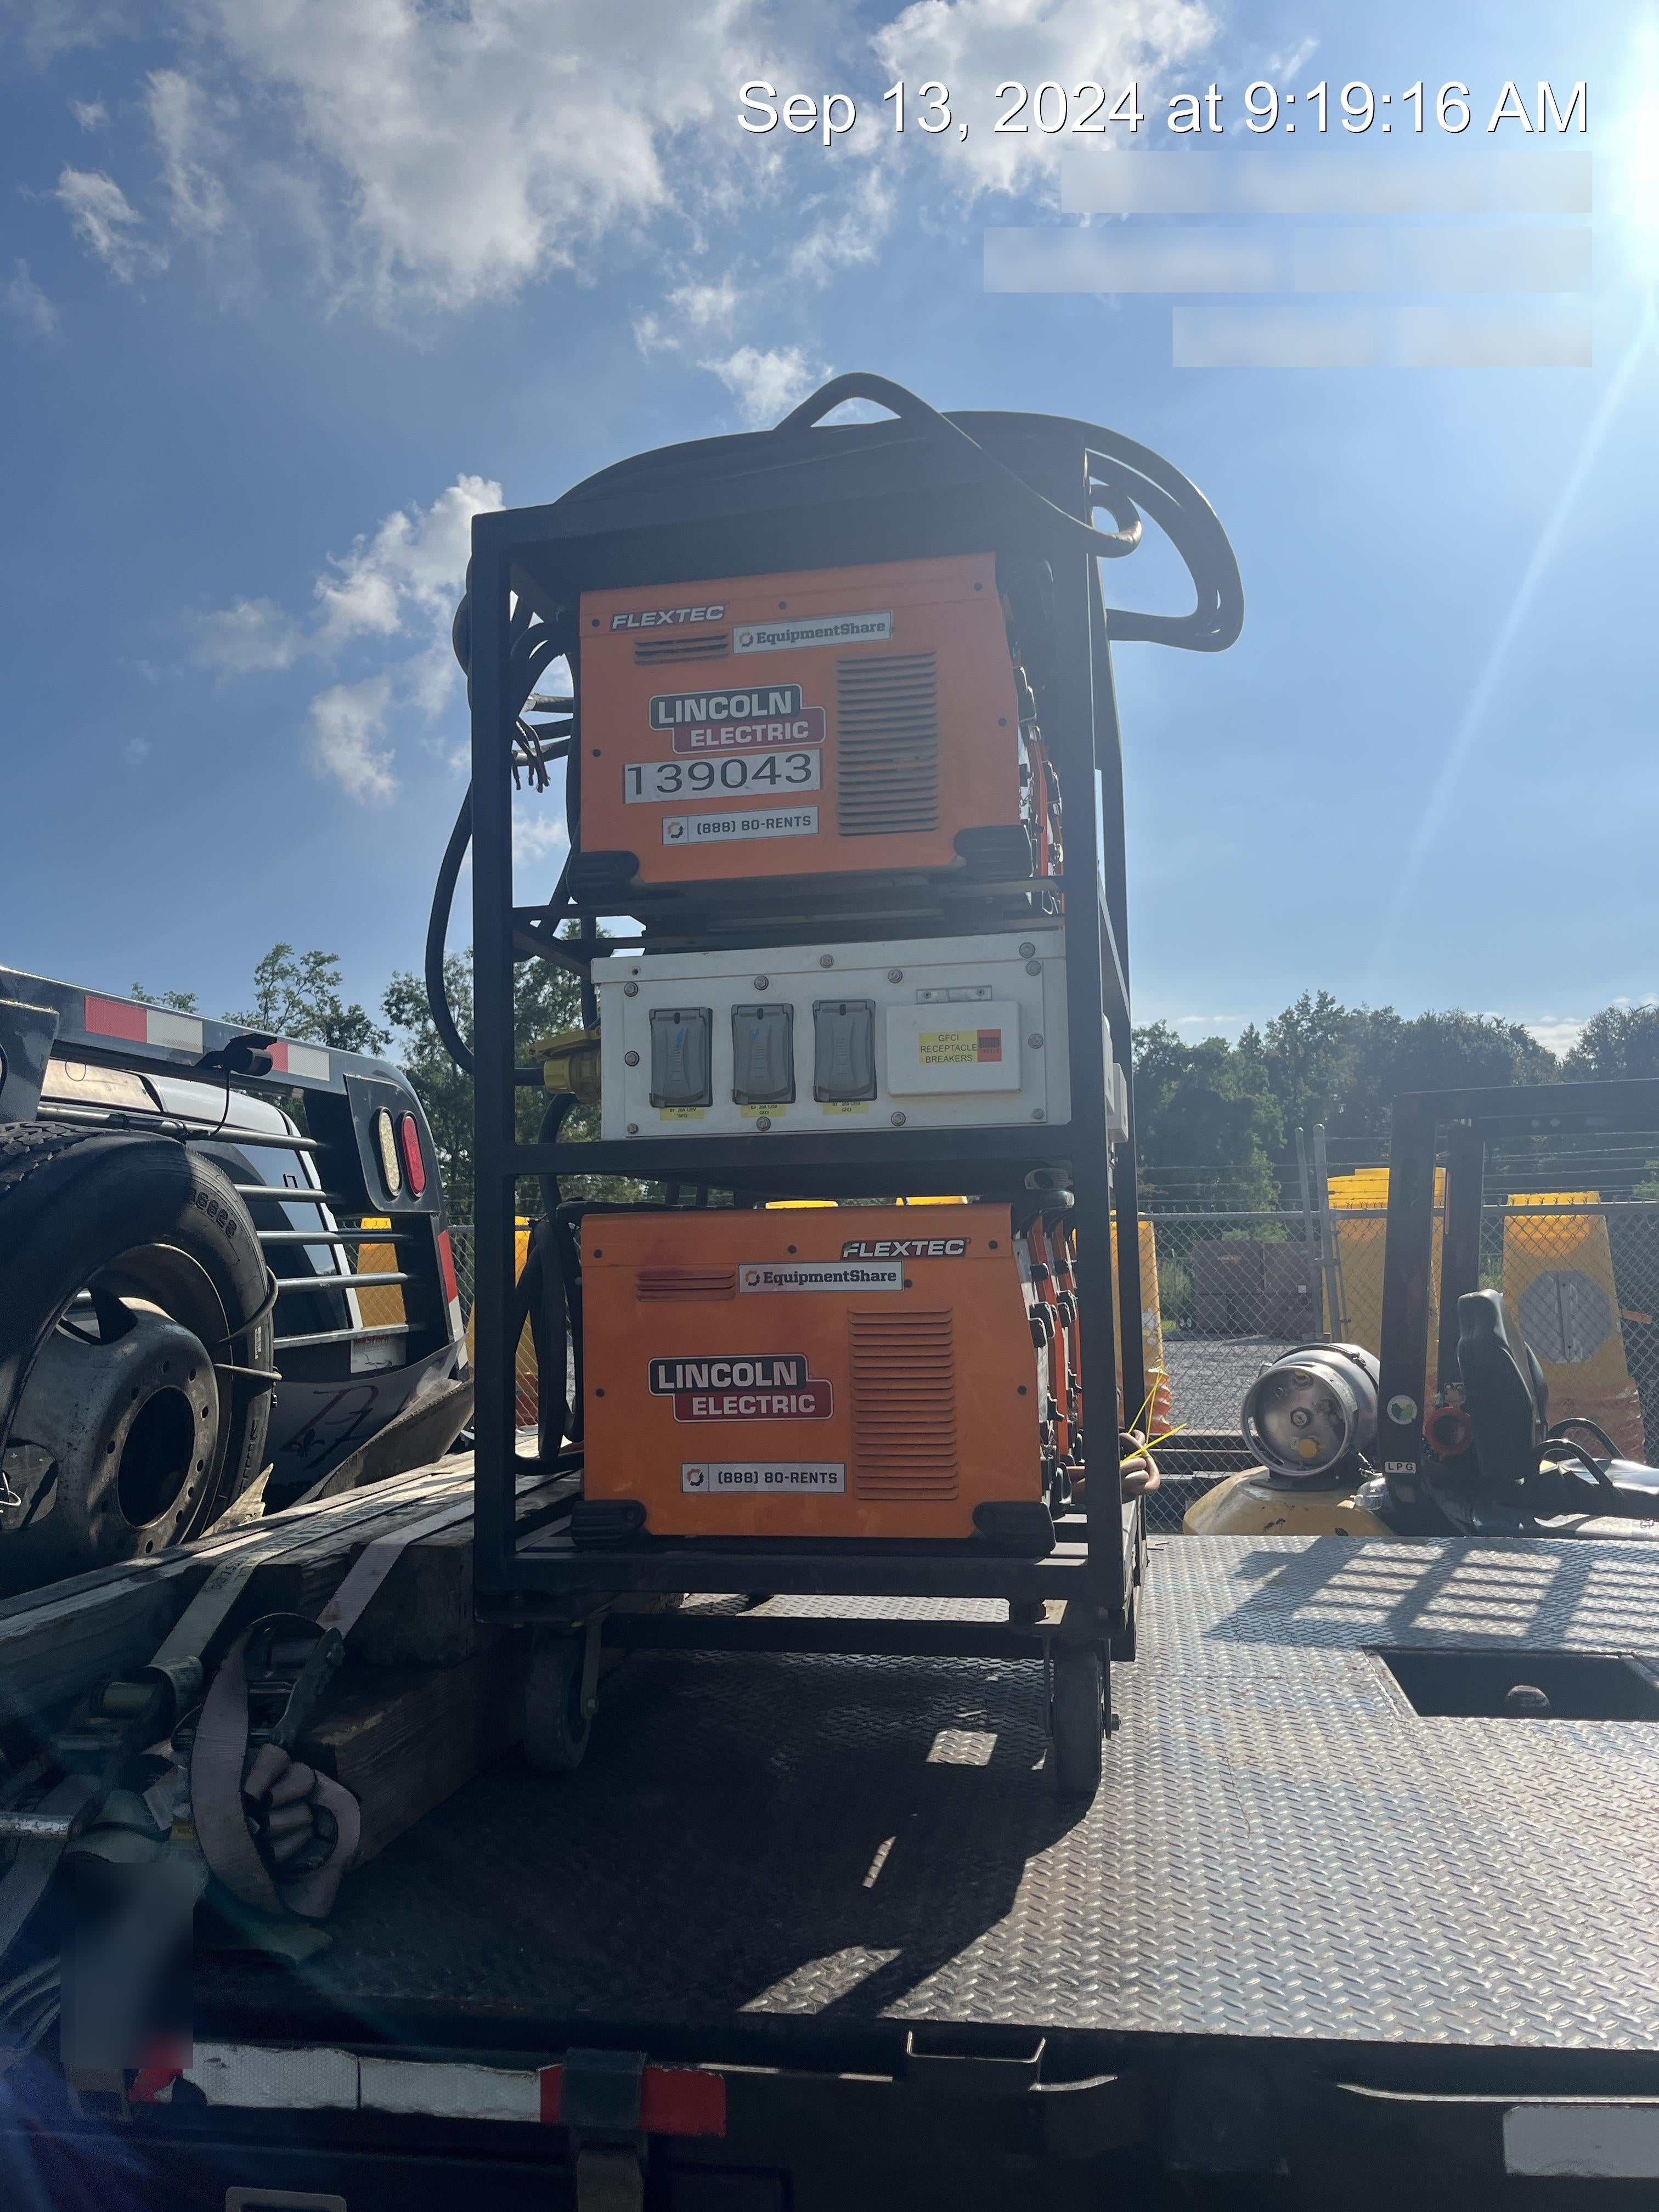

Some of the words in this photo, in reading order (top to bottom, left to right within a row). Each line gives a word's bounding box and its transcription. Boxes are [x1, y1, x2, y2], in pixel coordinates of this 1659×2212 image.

[612, 605, 724, 629] FLEXTEC
[757, 620, 885, 645] EquipmentShare
[658, 691, 792, 724] LINCOLN
[691, 721, 809, 747] ELECTRIC
[627, 753, 812, 795] 139043
[697, 819, 736, 834] (888)
[741, 815, 811, 831] 80-RENTS
[921, 1044, 978, 1053] RECEPTACLE
[926, 1054, 973, 1063] BREAKERS
[843, 1239, 965, 1258] FLEXTEC
[763, 1269, 897, 1287] EquipmentShare
[658, 1361, 797, 1390] LINCOLN
[692, 1394, 815, 1415] ELECTRIC
[718, 1470, 759, 1485] (888)
[764, 1471, 838, 1485] 80-RENTS
